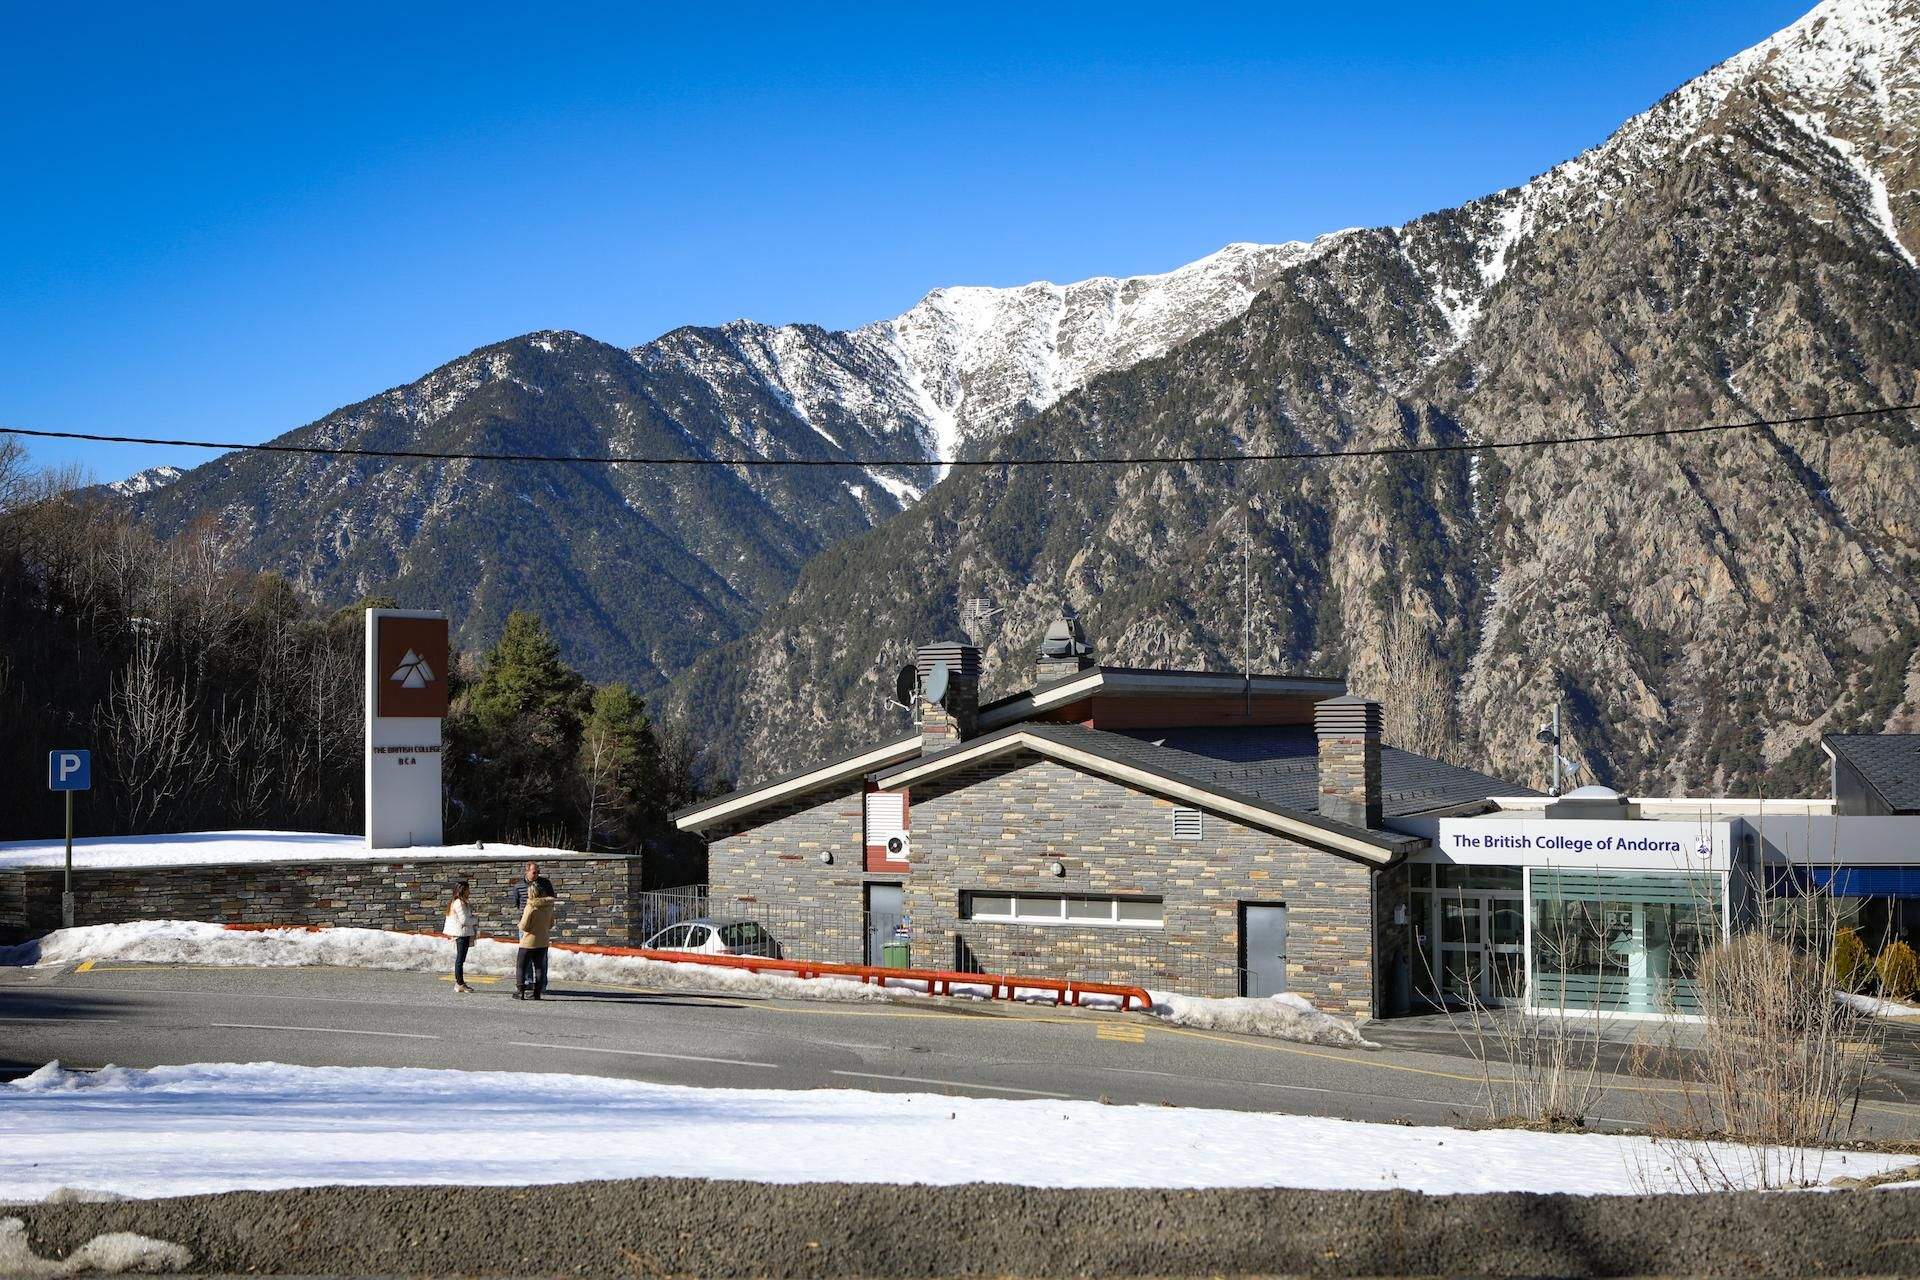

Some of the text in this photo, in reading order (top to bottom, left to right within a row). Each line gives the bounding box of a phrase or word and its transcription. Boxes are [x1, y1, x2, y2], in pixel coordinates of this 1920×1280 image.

[374, 745, 441, 754] THE BRITISH COLLEGE
[60, 754, 81, 781] P
[1452, 834, 1480, 848] The
[1484, 835, 1531, 849] British
[1535, 836, 1593, 853] College
[1596, 836, 1613, 851] of
[1616, 837, 1680, 852] Andorra
